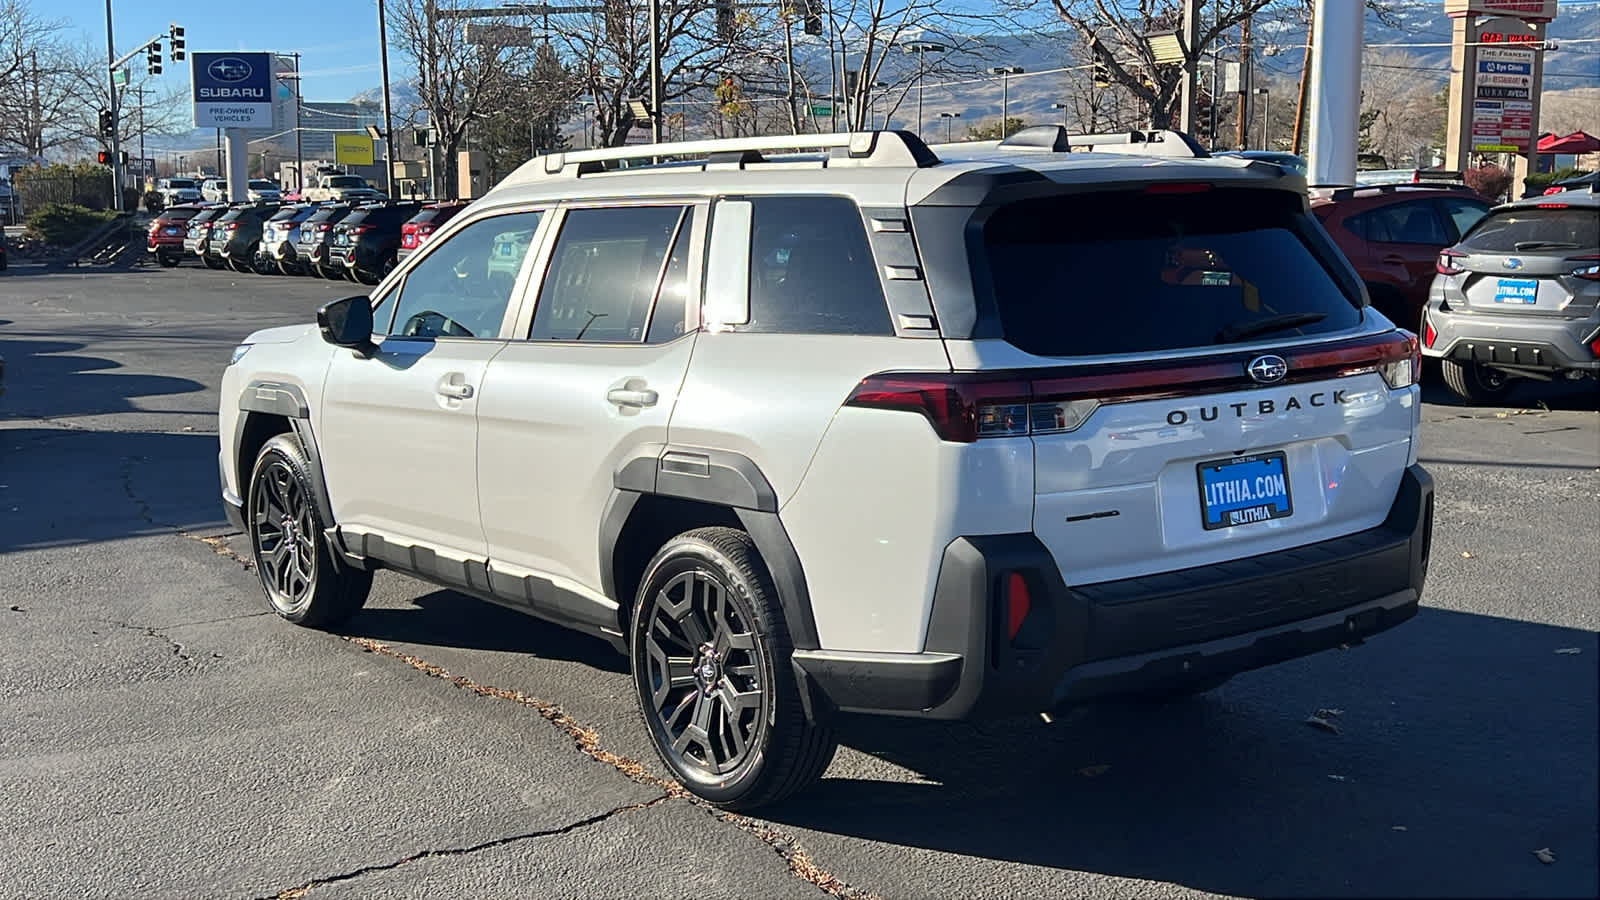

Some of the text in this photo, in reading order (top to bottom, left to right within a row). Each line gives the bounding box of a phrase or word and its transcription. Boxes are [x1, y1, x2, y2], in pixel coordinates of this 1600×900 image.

[200, 87, 264, 98] SUBARU
[209, 107, 256, 115] PRE-OWNED
[1166, 389, 1349, 426] OUTBACK
[1204, 473, 1287, 507] LITHIA.COM
[1239, 506, 1271, 523] LITHIA
